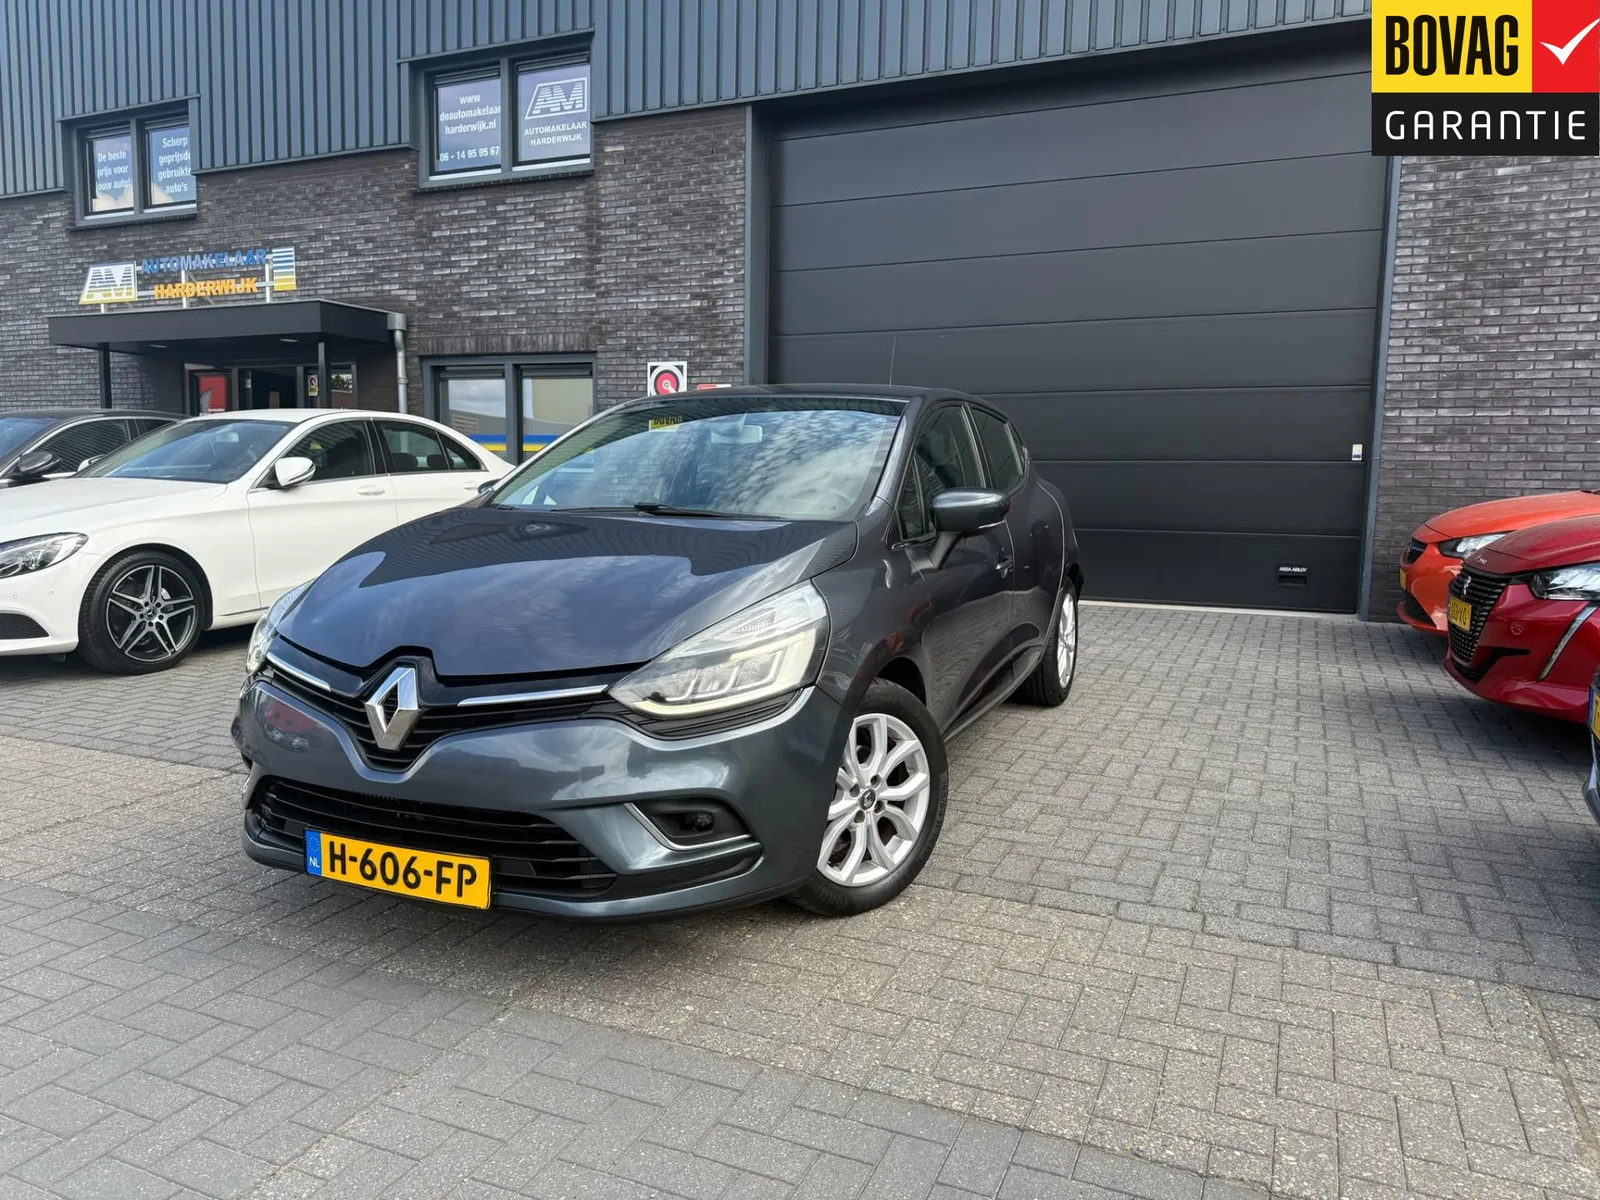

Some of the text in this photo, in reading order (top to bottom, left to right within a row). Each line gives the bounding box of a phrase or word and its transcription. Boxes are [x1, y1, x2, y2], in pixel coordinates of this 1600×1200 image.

[459, 94, 481, 105] www
[445, 118, 497, 135] harderwijk.nl
[524, 121, 588, 136] AUTOMAKELAAR
[162, 136, 188, 149] Scherp
[530, 132, 583, 146] HARDERWIJK
[97, 150, 127, 162] De beste
[439, 152, 449, 162] 06
[456, 150, 466, 160] 14
[467, 148, 477, 159] 95
[478, 147, 488, 158] 95
[490, 145, 501, 156] 67
[97, 165, 129, 179] prijs voor
[113, 178, 132, 189] auto!
[165, 182, 189, 194] auto's
[141, 249, 267, 274] AUTOMAKELAAR
[154, 278, 258, 299] HARDERWIJK
[309, 855, 321, 868] NL
[329, 840, 478, 898] H-606-FP
